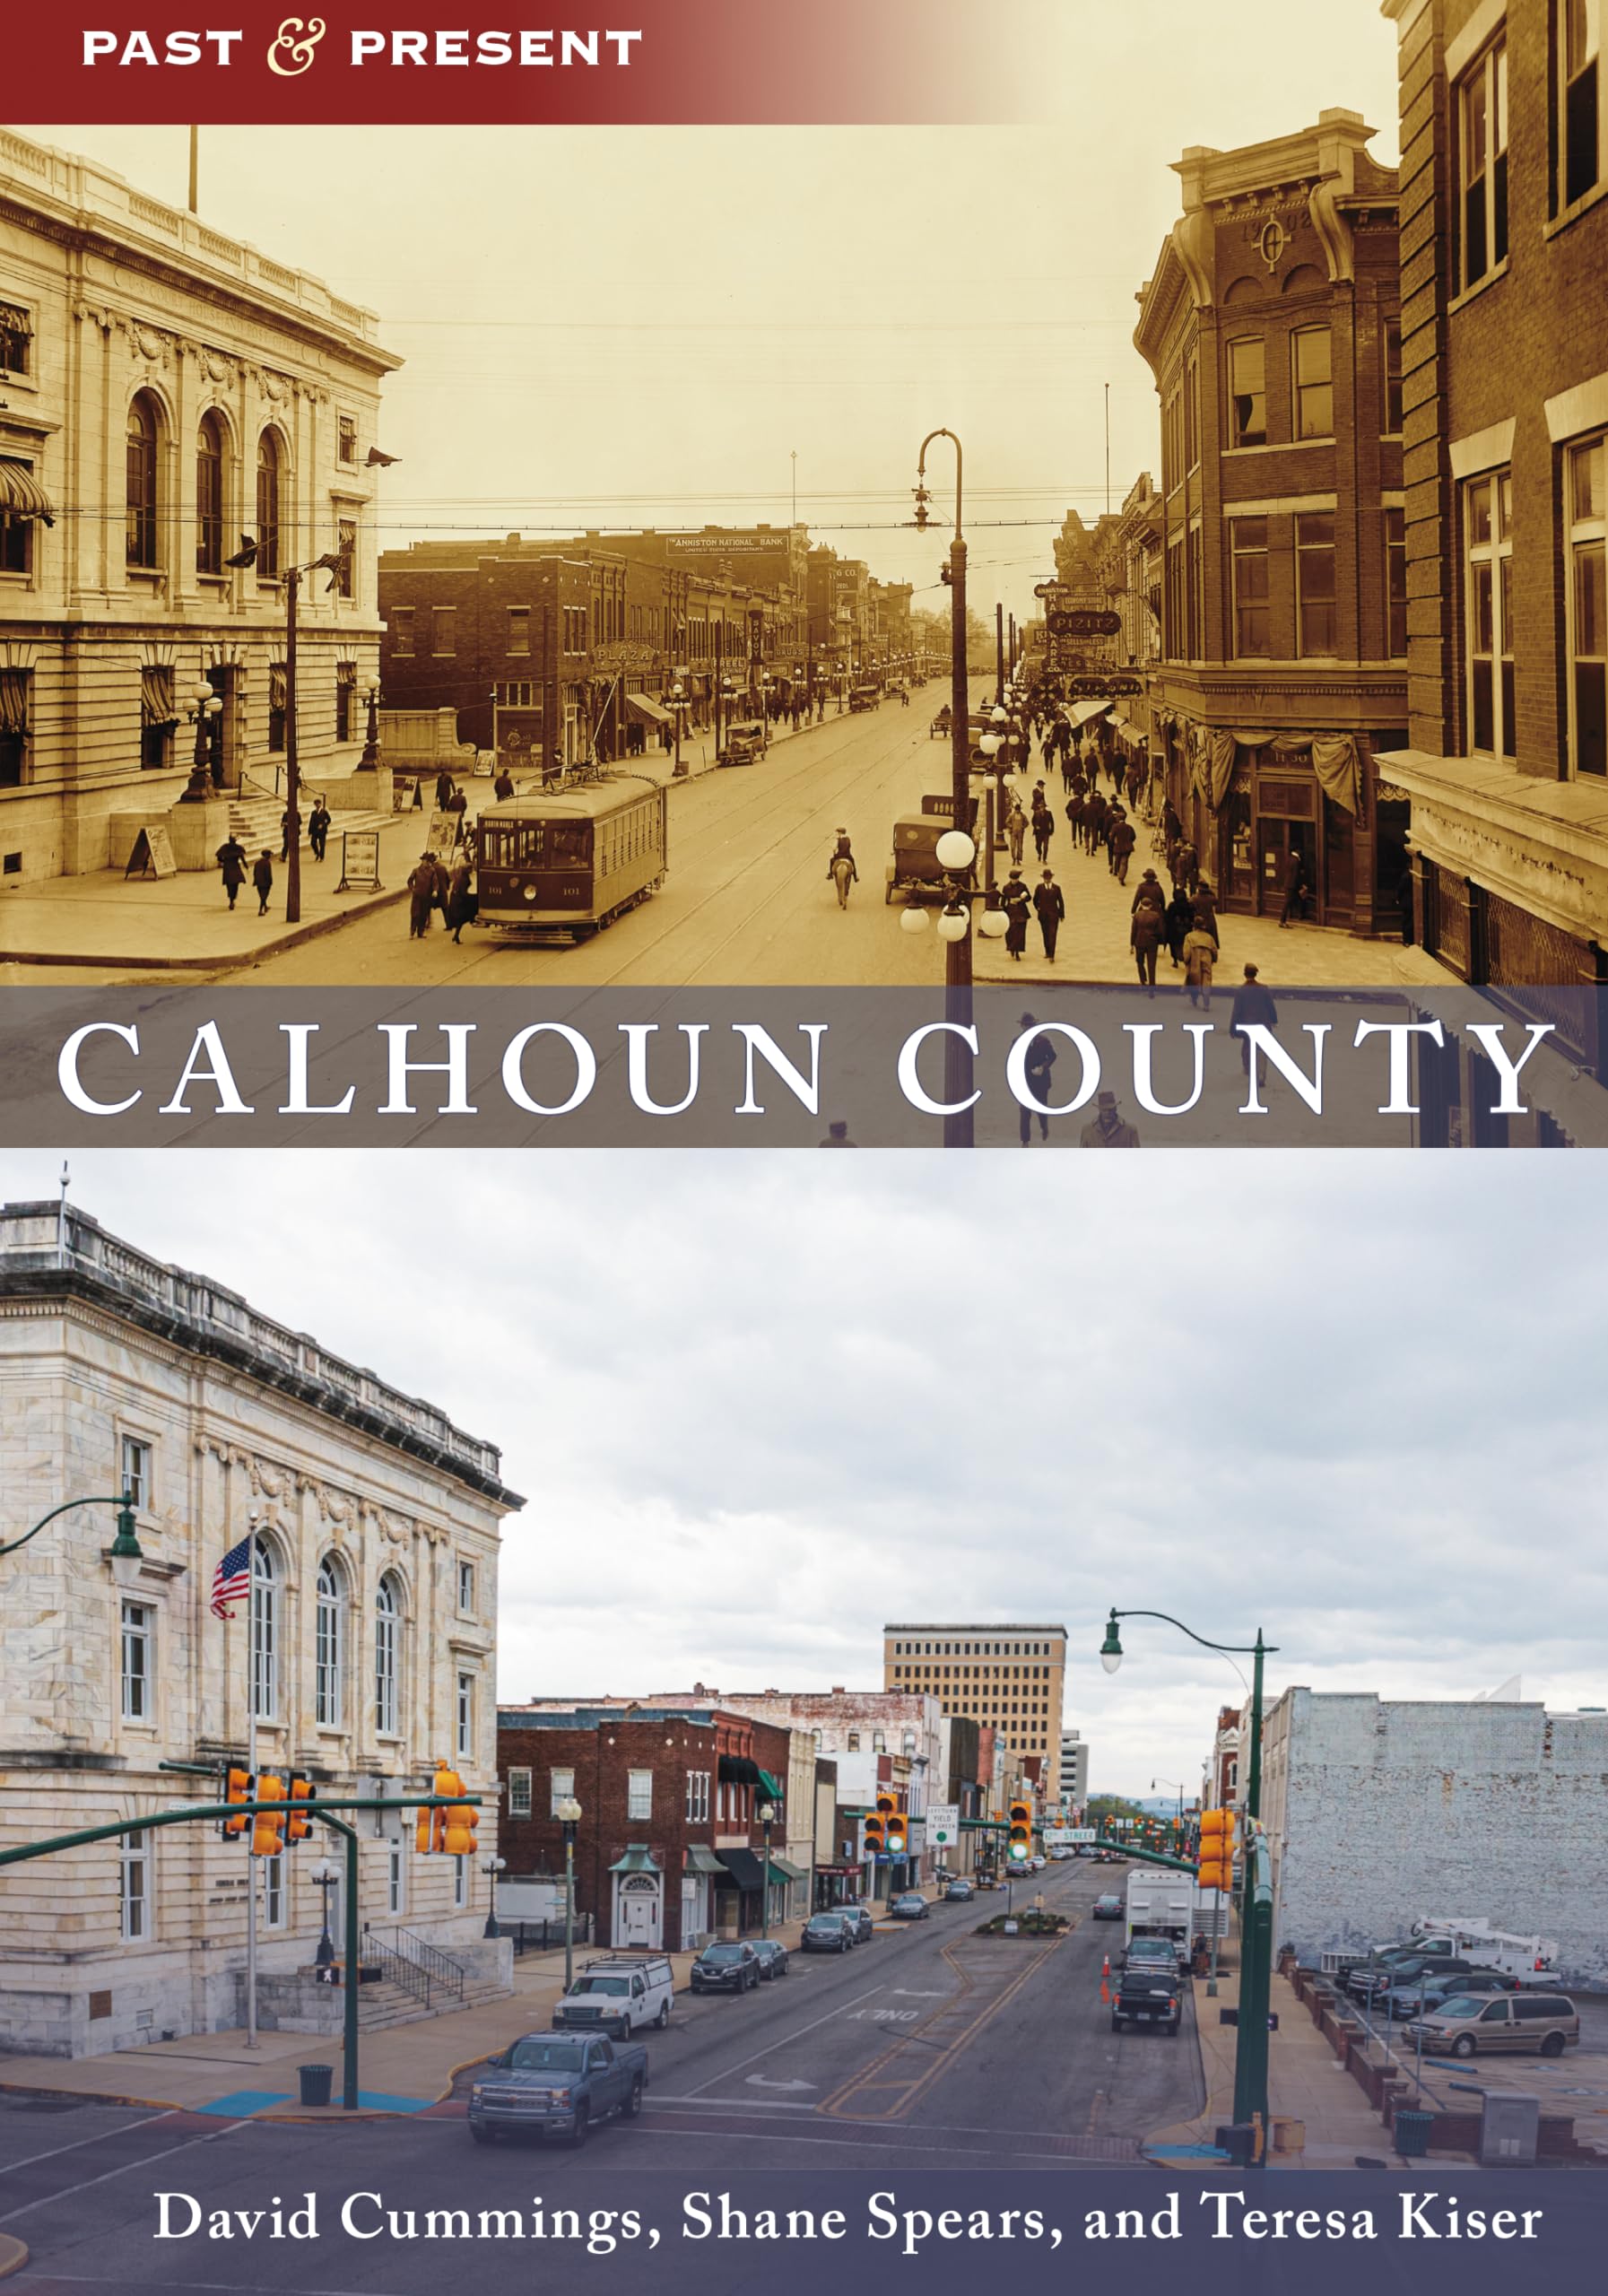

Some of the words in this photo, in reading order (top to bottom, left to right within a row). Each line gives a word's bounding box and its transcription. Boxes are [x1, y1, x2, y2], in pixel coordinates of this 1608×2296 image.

[675, 538, 717, 547] ANNISTON
[718, 537, 754, 546] NATIONAL
[760, 537, 783, 545] BANK
[1056, 616, 1115, 630] PIZITZ
[752, 619, 761, 657] SAVOY
[597, 649, 649, 660] PLAZA
[489, 886, 502, 895] 101
[563, 887, 580, 896] 101
[933, 1814, 952, 1822] YIELD
[1064, 1831, 1094, 1840] STREET
[847, 2009, 919, 2021] ONLY
